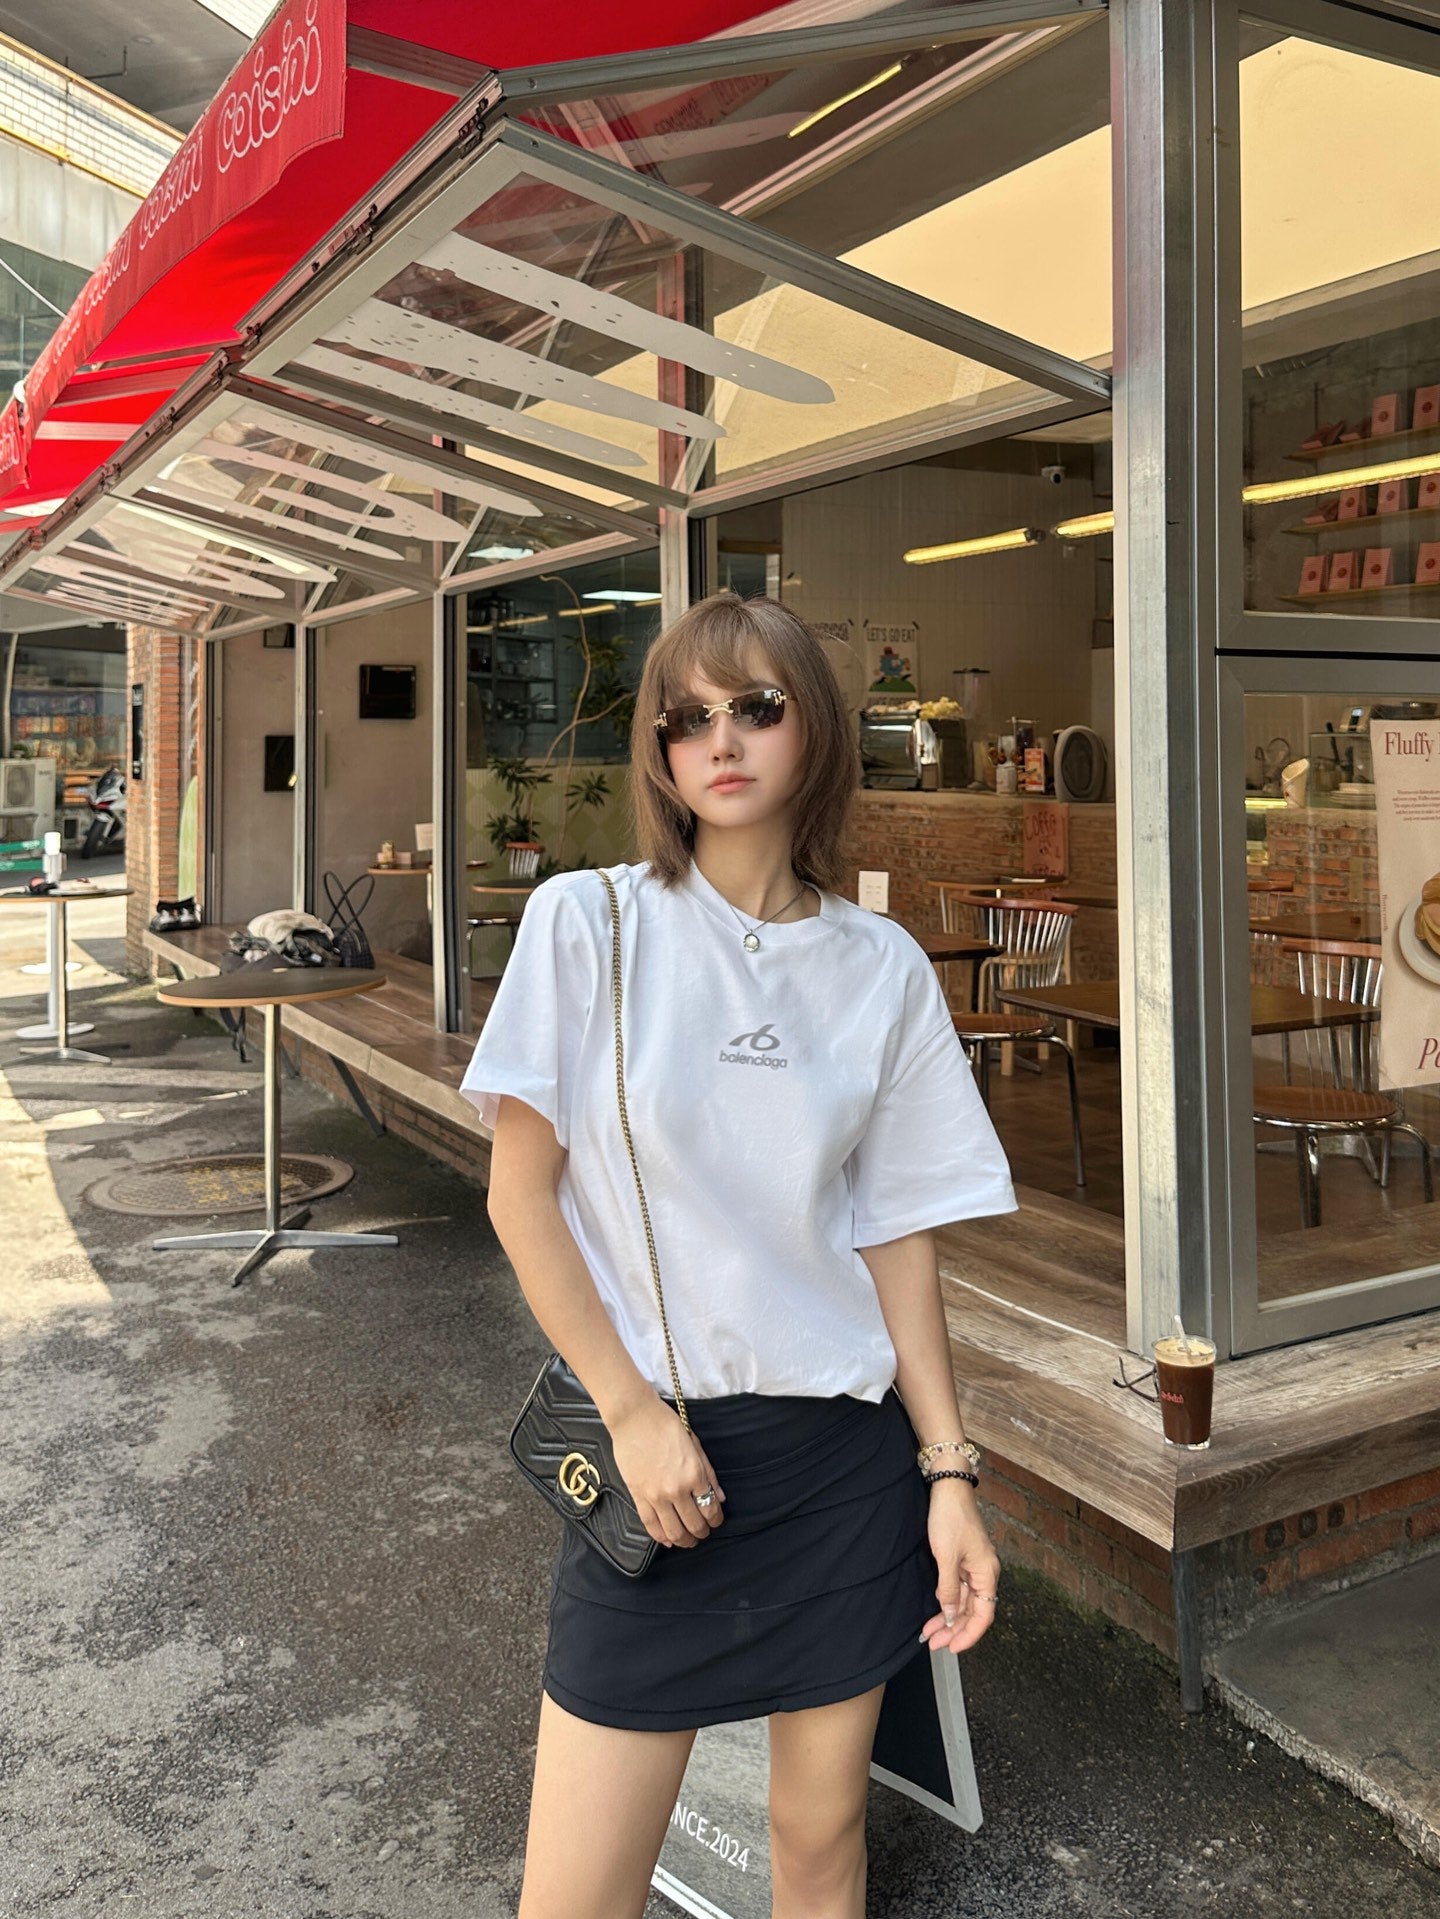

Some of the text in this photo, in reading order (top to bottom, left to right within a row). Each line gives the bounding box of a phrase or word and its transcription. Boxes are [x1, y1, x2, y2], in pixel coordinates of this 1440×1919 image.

[866, 627, 887, 642] LET'S
[888, 628, 901, 642] GO
[902, 628, 916, 643] EAT
[1384, 731, 1434, 762] Fluffy
[718, 1050, 788, 1070] balenciaga
